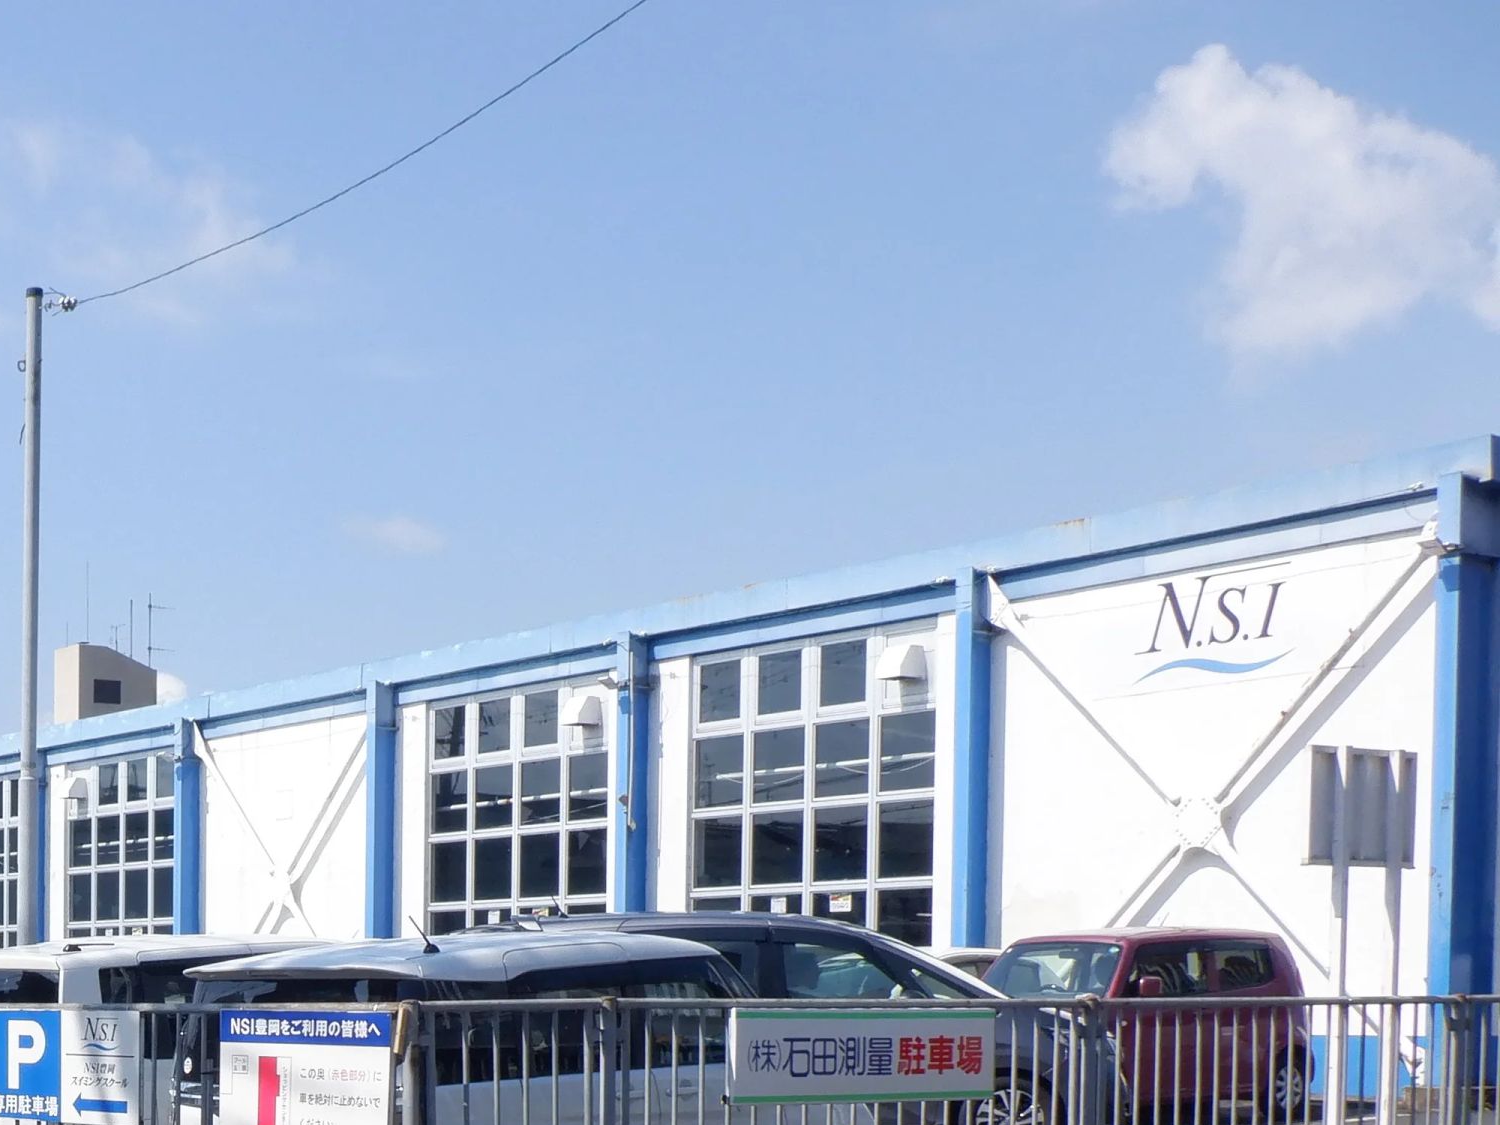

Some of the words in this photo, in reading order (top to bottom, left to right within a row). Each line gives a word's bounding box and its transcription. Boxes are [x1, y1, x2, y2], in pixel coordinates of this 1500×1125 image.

[1134, 571, 1288, 656] N.S.I
[81, 1017, 118, 1043] N.S.I
[230, 1017, 381, 1039] NSI豊岡をご利用の皆様へ
[8, 1019, 46, 1090] P
[71, 1076, 129, 1088] スイミングスクール
